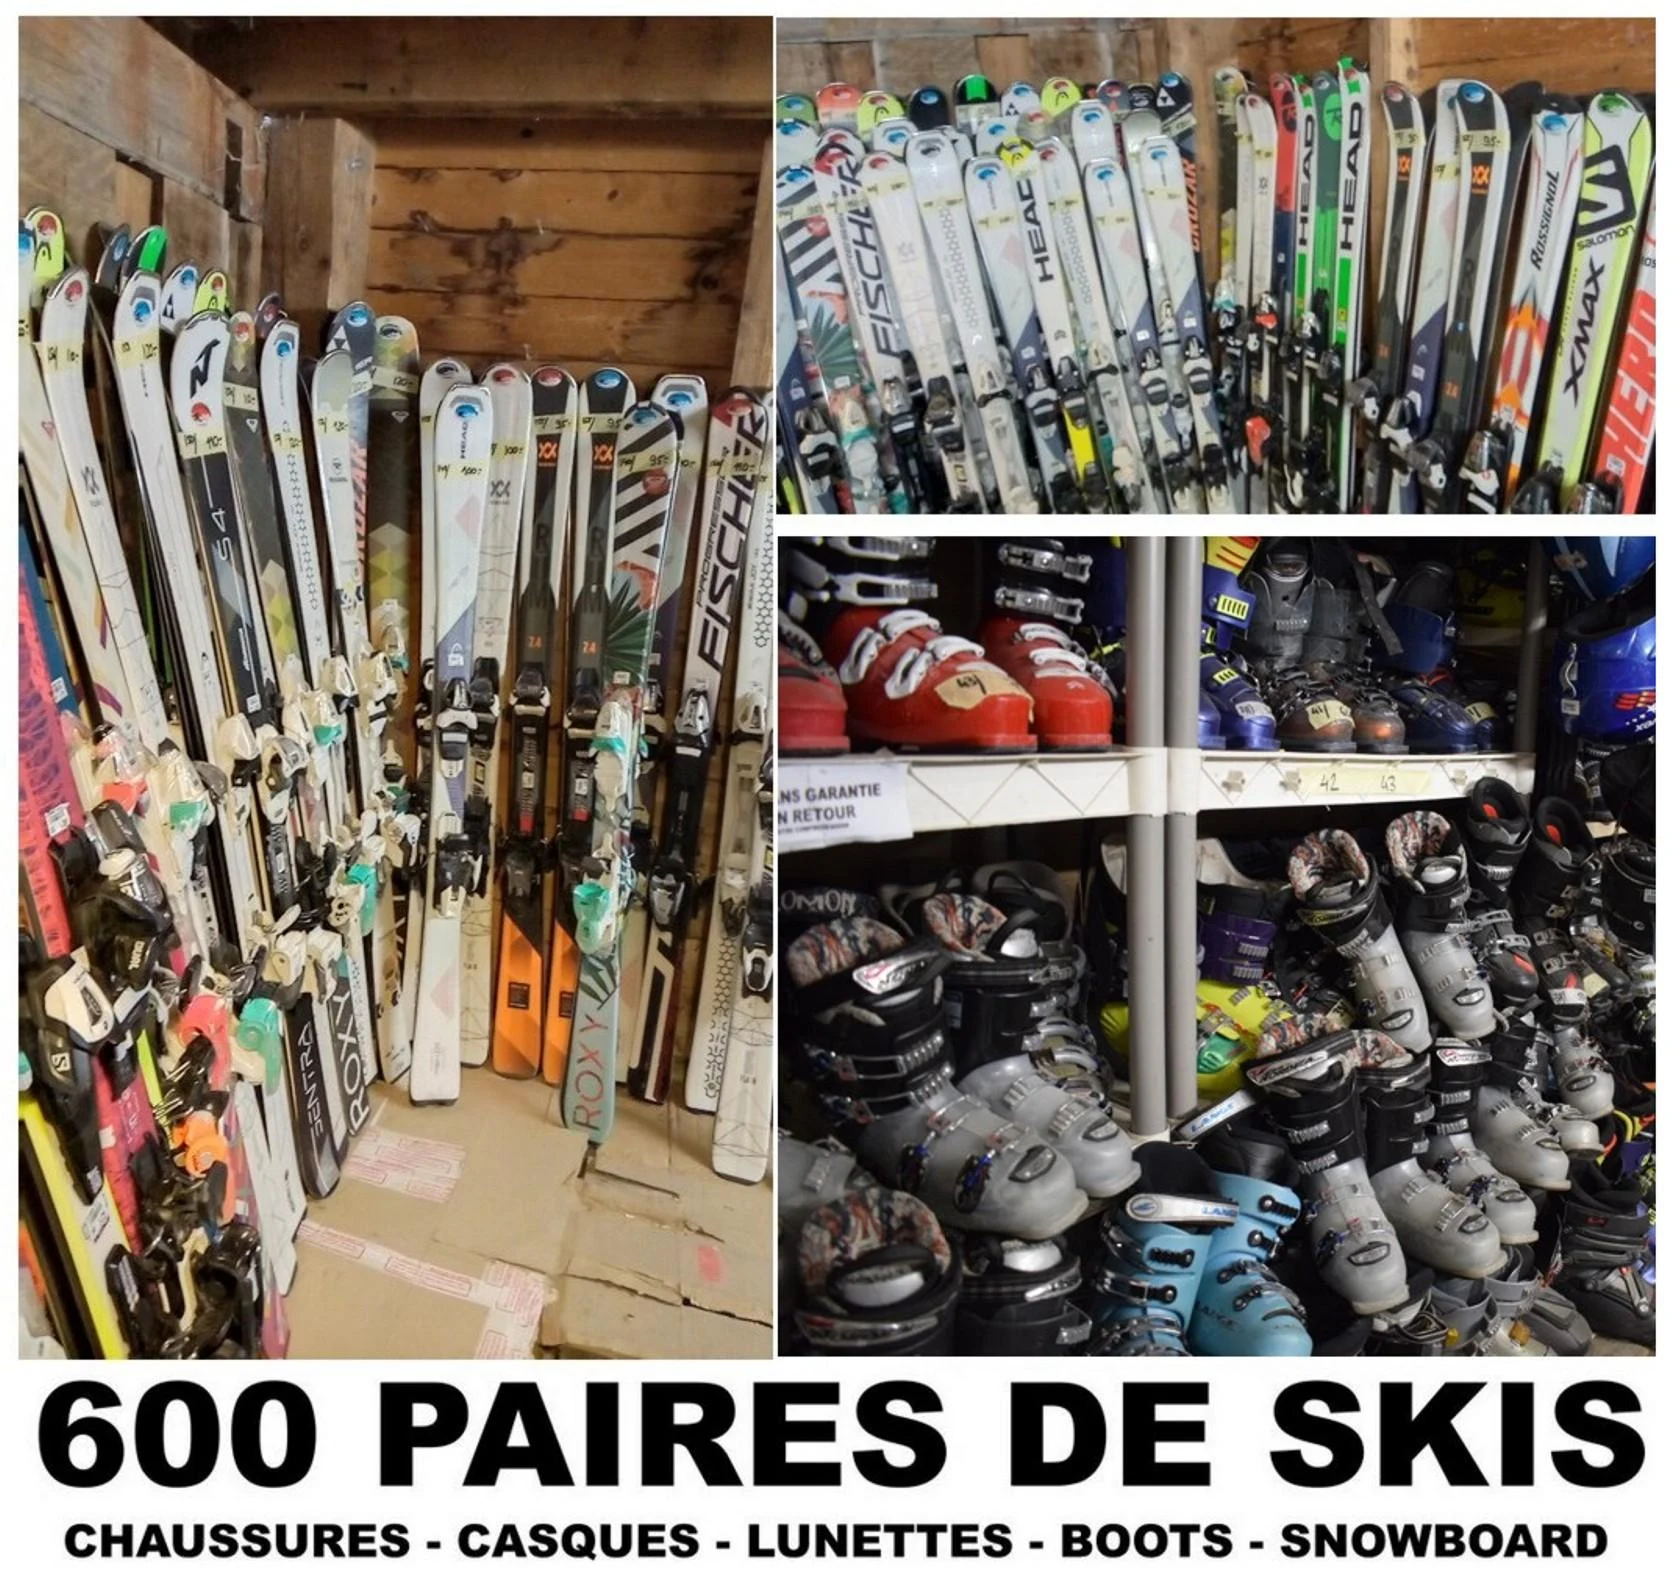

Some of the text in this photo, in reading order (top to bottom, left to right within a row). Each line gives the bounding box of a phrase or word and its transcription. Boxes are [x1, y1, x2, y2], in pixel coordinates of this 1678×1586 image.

[1017, 178, 1054, 284] HEAD
[1299, 113, 1316, 247] HEAD
[1340, 101, 1363, 250] HEAD
[793, 805, 856, 823] RETOUR
[805, 782, 882, 802] GARANTIE
[332, 990, 370, 1136] ROXY
[573, 1013, 609, 1131] ROXY
